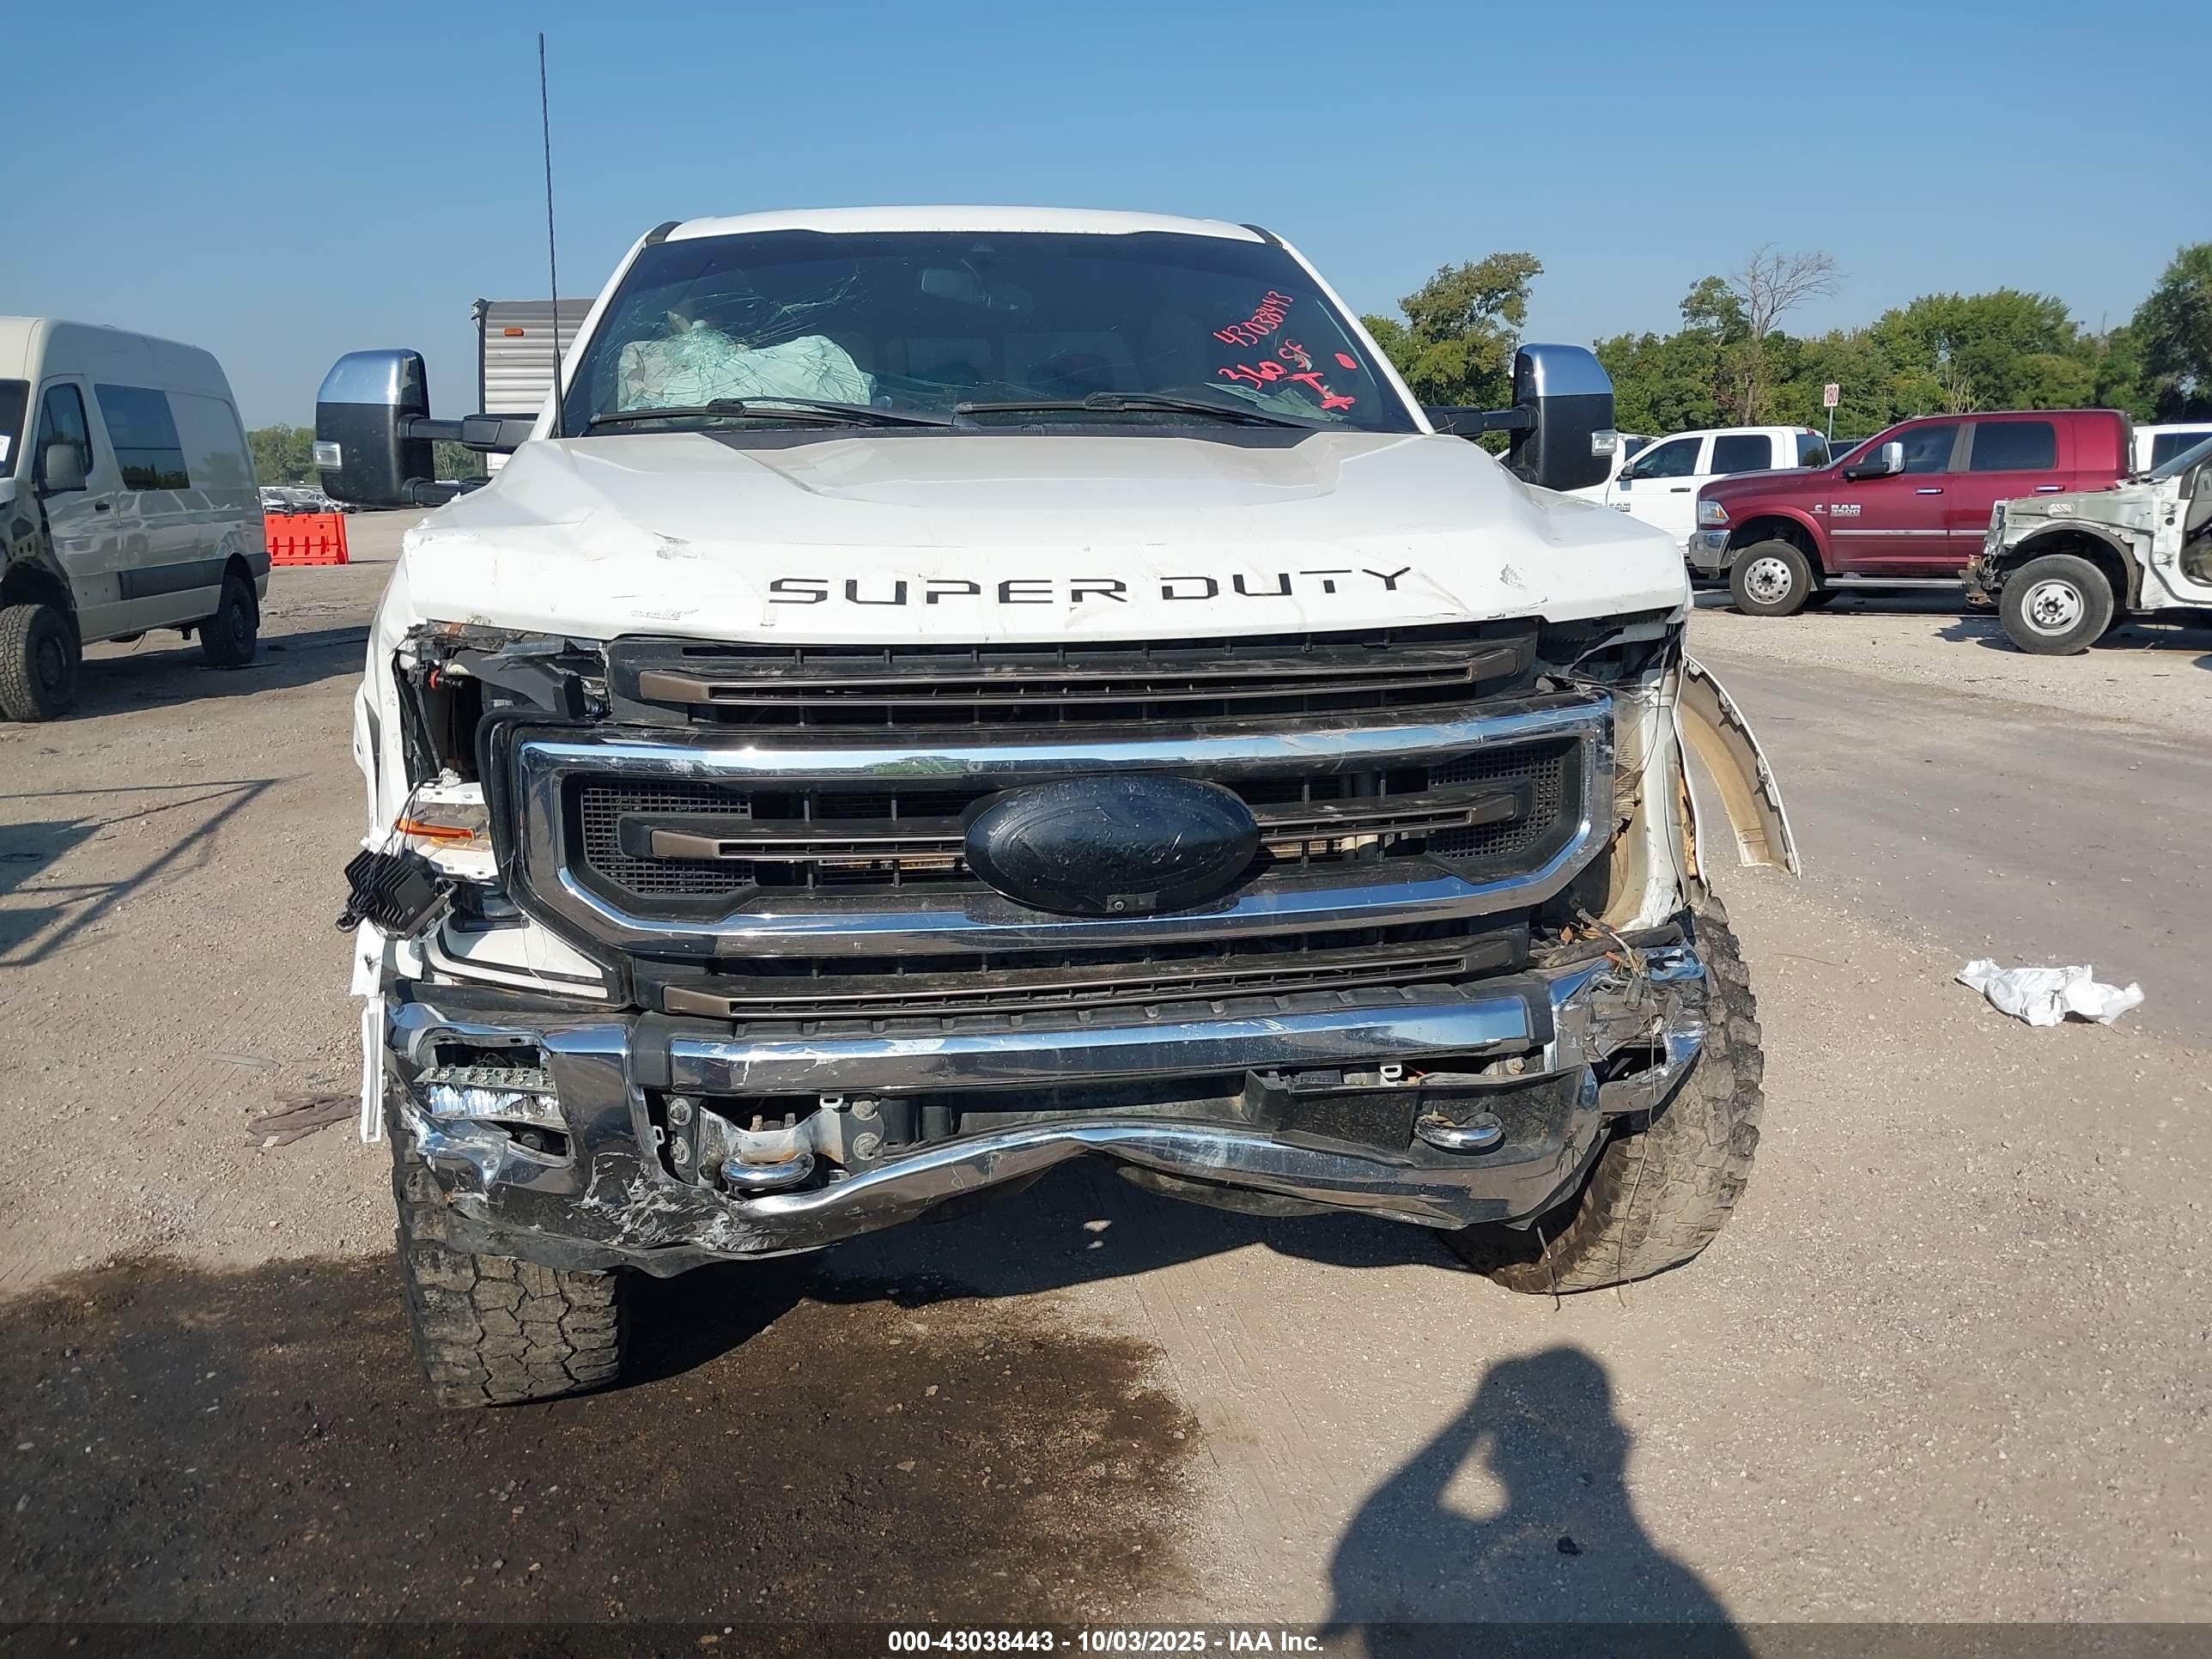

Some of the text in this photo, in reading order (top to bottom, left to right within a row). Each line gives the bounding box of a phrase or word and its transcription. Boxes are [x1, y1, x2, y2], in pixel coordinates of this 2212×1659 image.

[1826, 386, 1838, 404] 180
[769, 567, 1412, 605] SUPER DUTY
